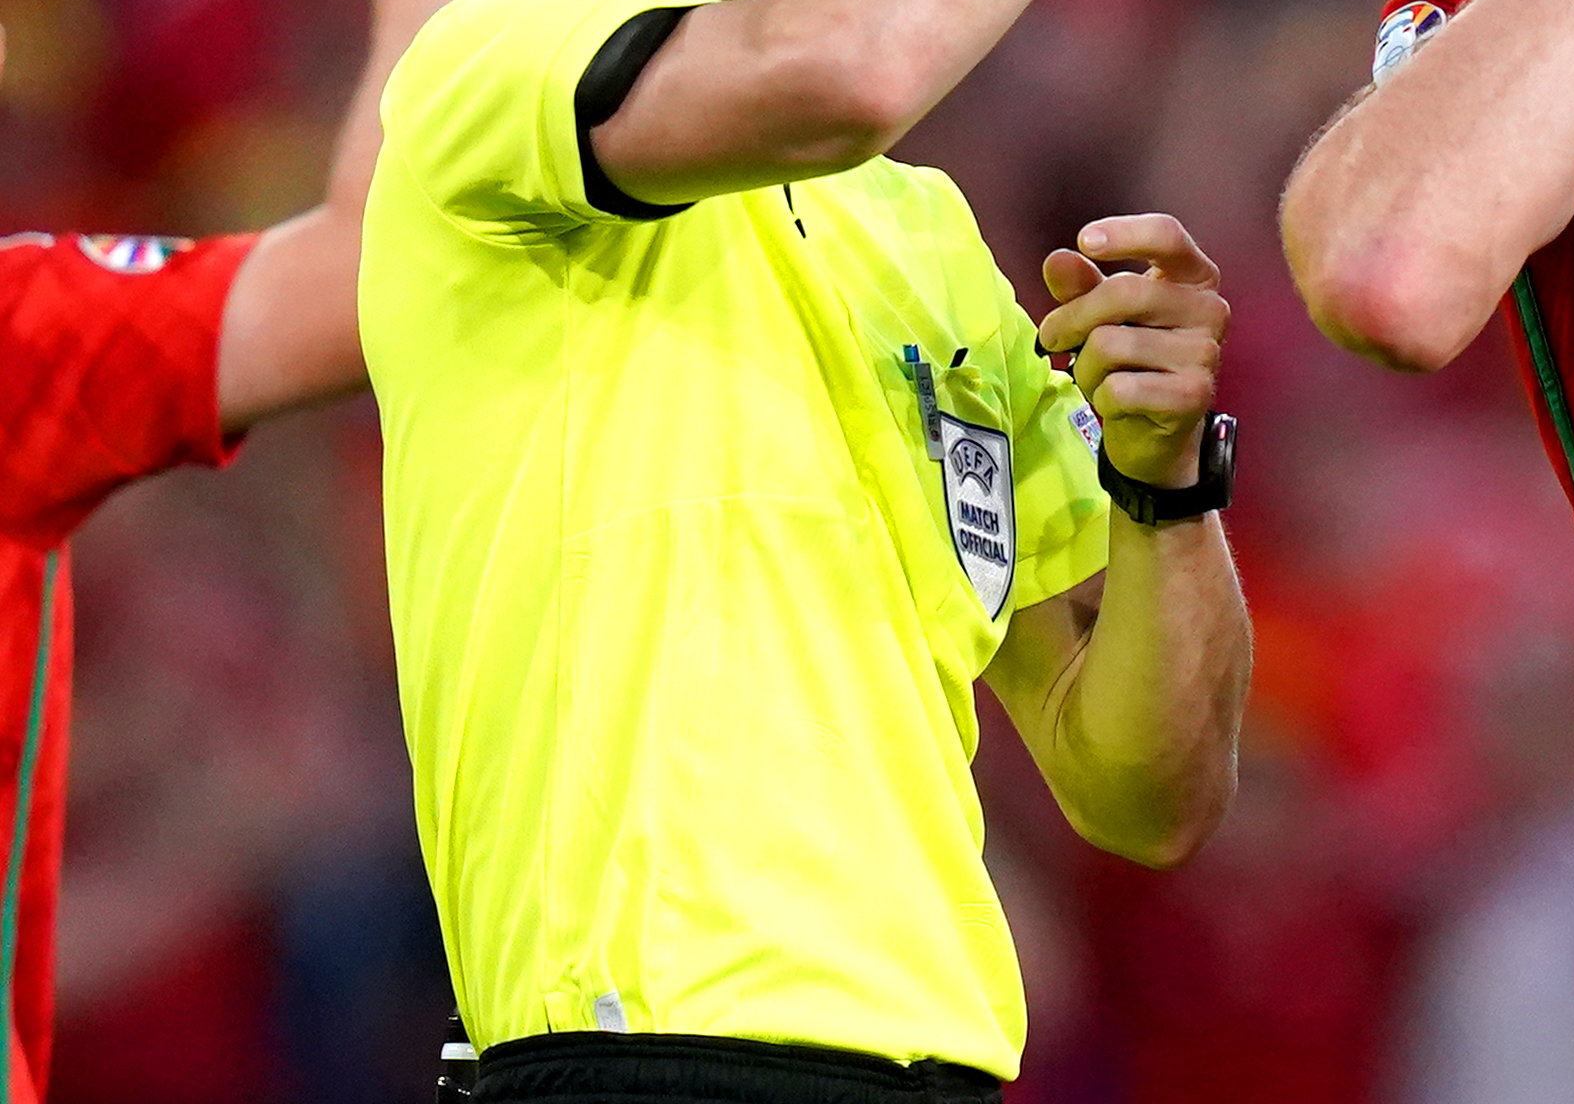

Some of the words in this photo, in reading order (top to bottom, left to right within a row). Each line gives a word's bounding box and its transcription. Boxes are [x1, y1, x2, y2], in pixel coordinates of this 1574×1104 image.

[953, 445, 993, 488] UEFA
[960, 500, 999, 533] MATCH
[959, 529, 1008, 565] OFFICIAL
